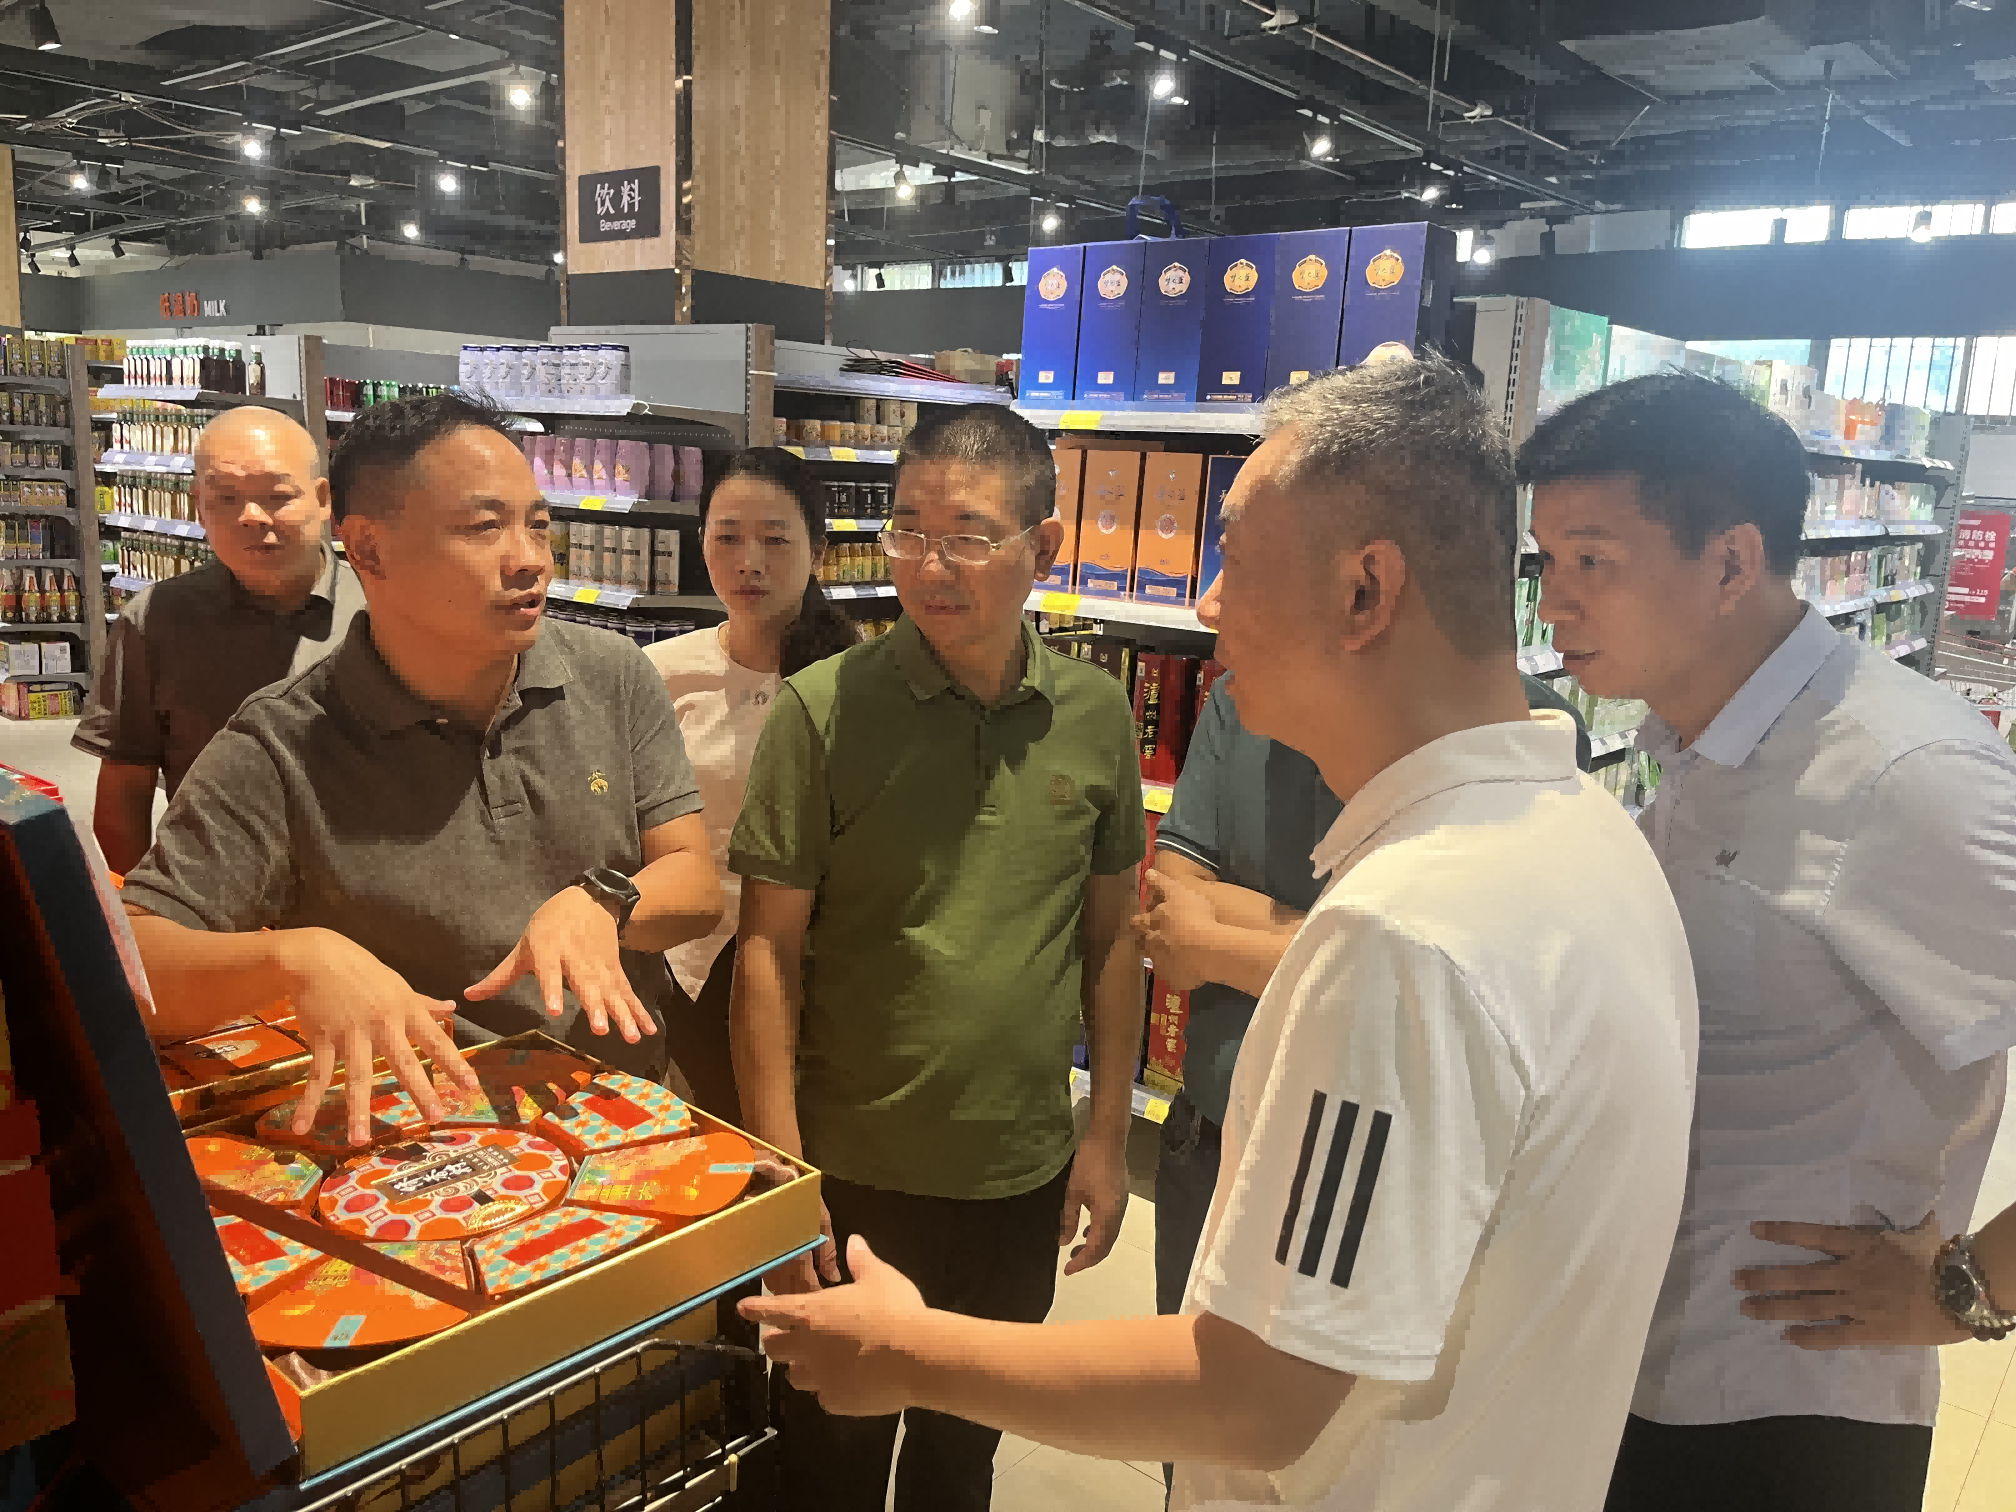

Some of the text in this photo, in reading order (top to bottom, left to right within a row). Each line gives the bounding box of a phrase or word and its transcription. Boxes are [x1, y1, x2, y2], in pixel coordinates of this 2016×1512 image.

[595, 179, 642, 216] 饮料
[600, 219, 636, 232] Beverage
[203, 299, 227, 317] MILK
[1959, 529, 1997, 542] 消防栓
